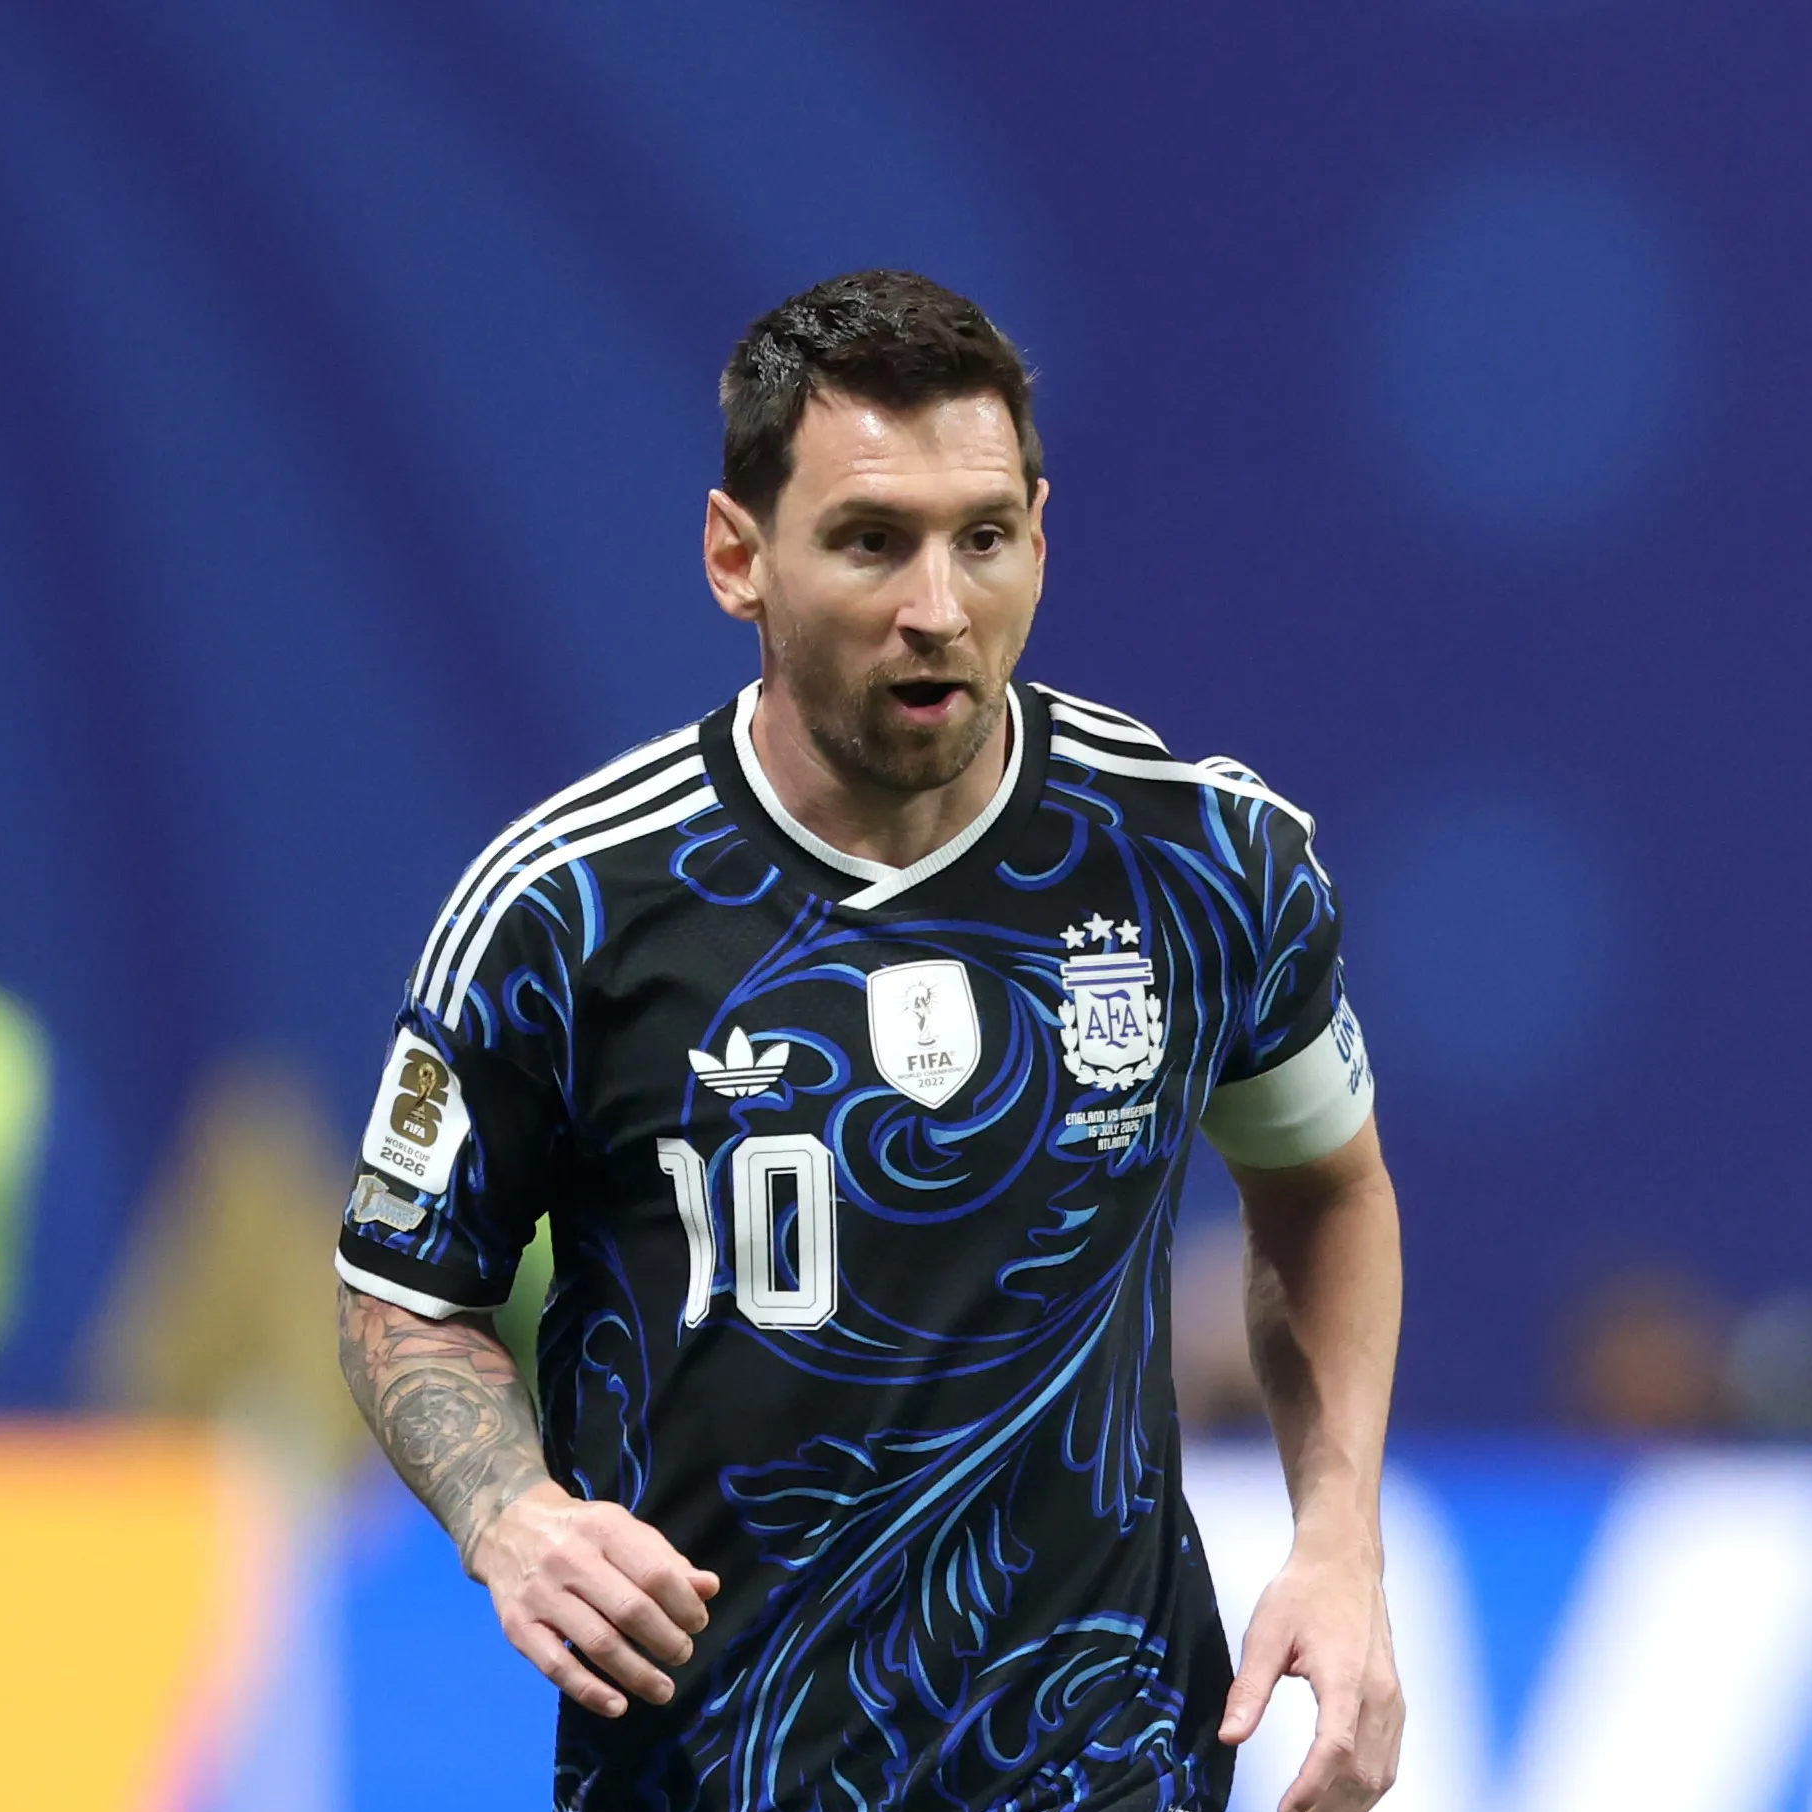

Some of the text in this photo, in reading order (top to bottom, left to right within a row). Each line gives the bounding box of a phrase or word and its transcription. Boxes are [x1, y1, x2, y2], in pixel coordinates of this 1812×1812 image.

[1085, 989, 1143, 1050] AFA
[907, 1051, 953, 1072] FIFA
[918, 1076, 945, 1088] 2022
[1065, 1110, 1105, 1126] ENGLAND
[402, 1120, 427, 1139] FIFA
[1088, 1125, 1097, 1138] 15
[1099, 1123, 1119, 1137] JULY
[384, 1135, 431, 1162] WORLD CUP
[1097, 1134, 1130, 1151] ATLANTA
[380, 1146, 427, 1178] 2026
[655, 1133, 838, 1331] 10
